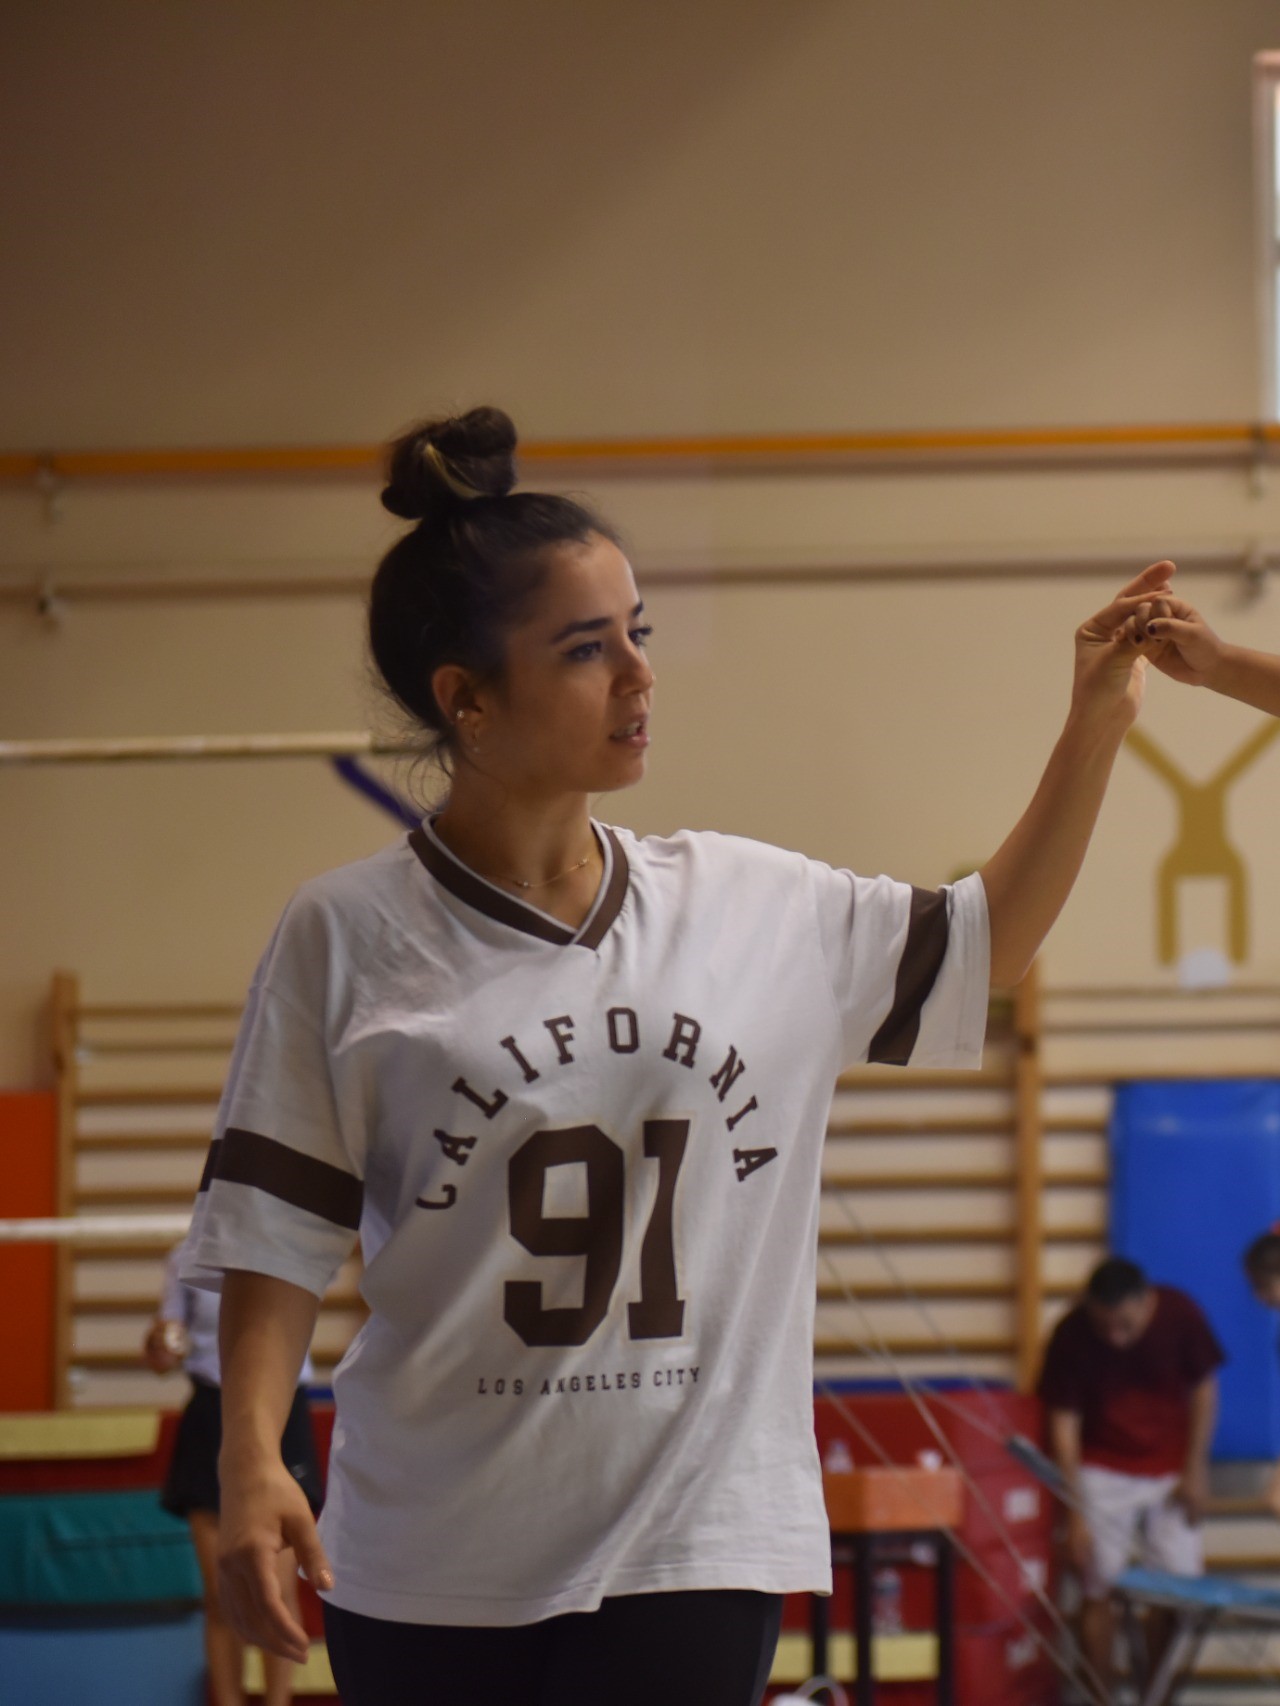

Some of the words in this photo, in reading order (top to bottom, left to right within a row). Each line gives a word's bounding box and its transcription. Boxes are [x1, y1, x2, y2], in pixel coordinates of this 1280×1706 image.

[415, 1007, 778, 1210] CALIFORNIA
[504, 1119, 691, 1347] 91
[477, 1377, 524, 1396] LOS
[539, 1372, 642, 1396] ANGELES
[653, 1366, 701, 1387] CITY
